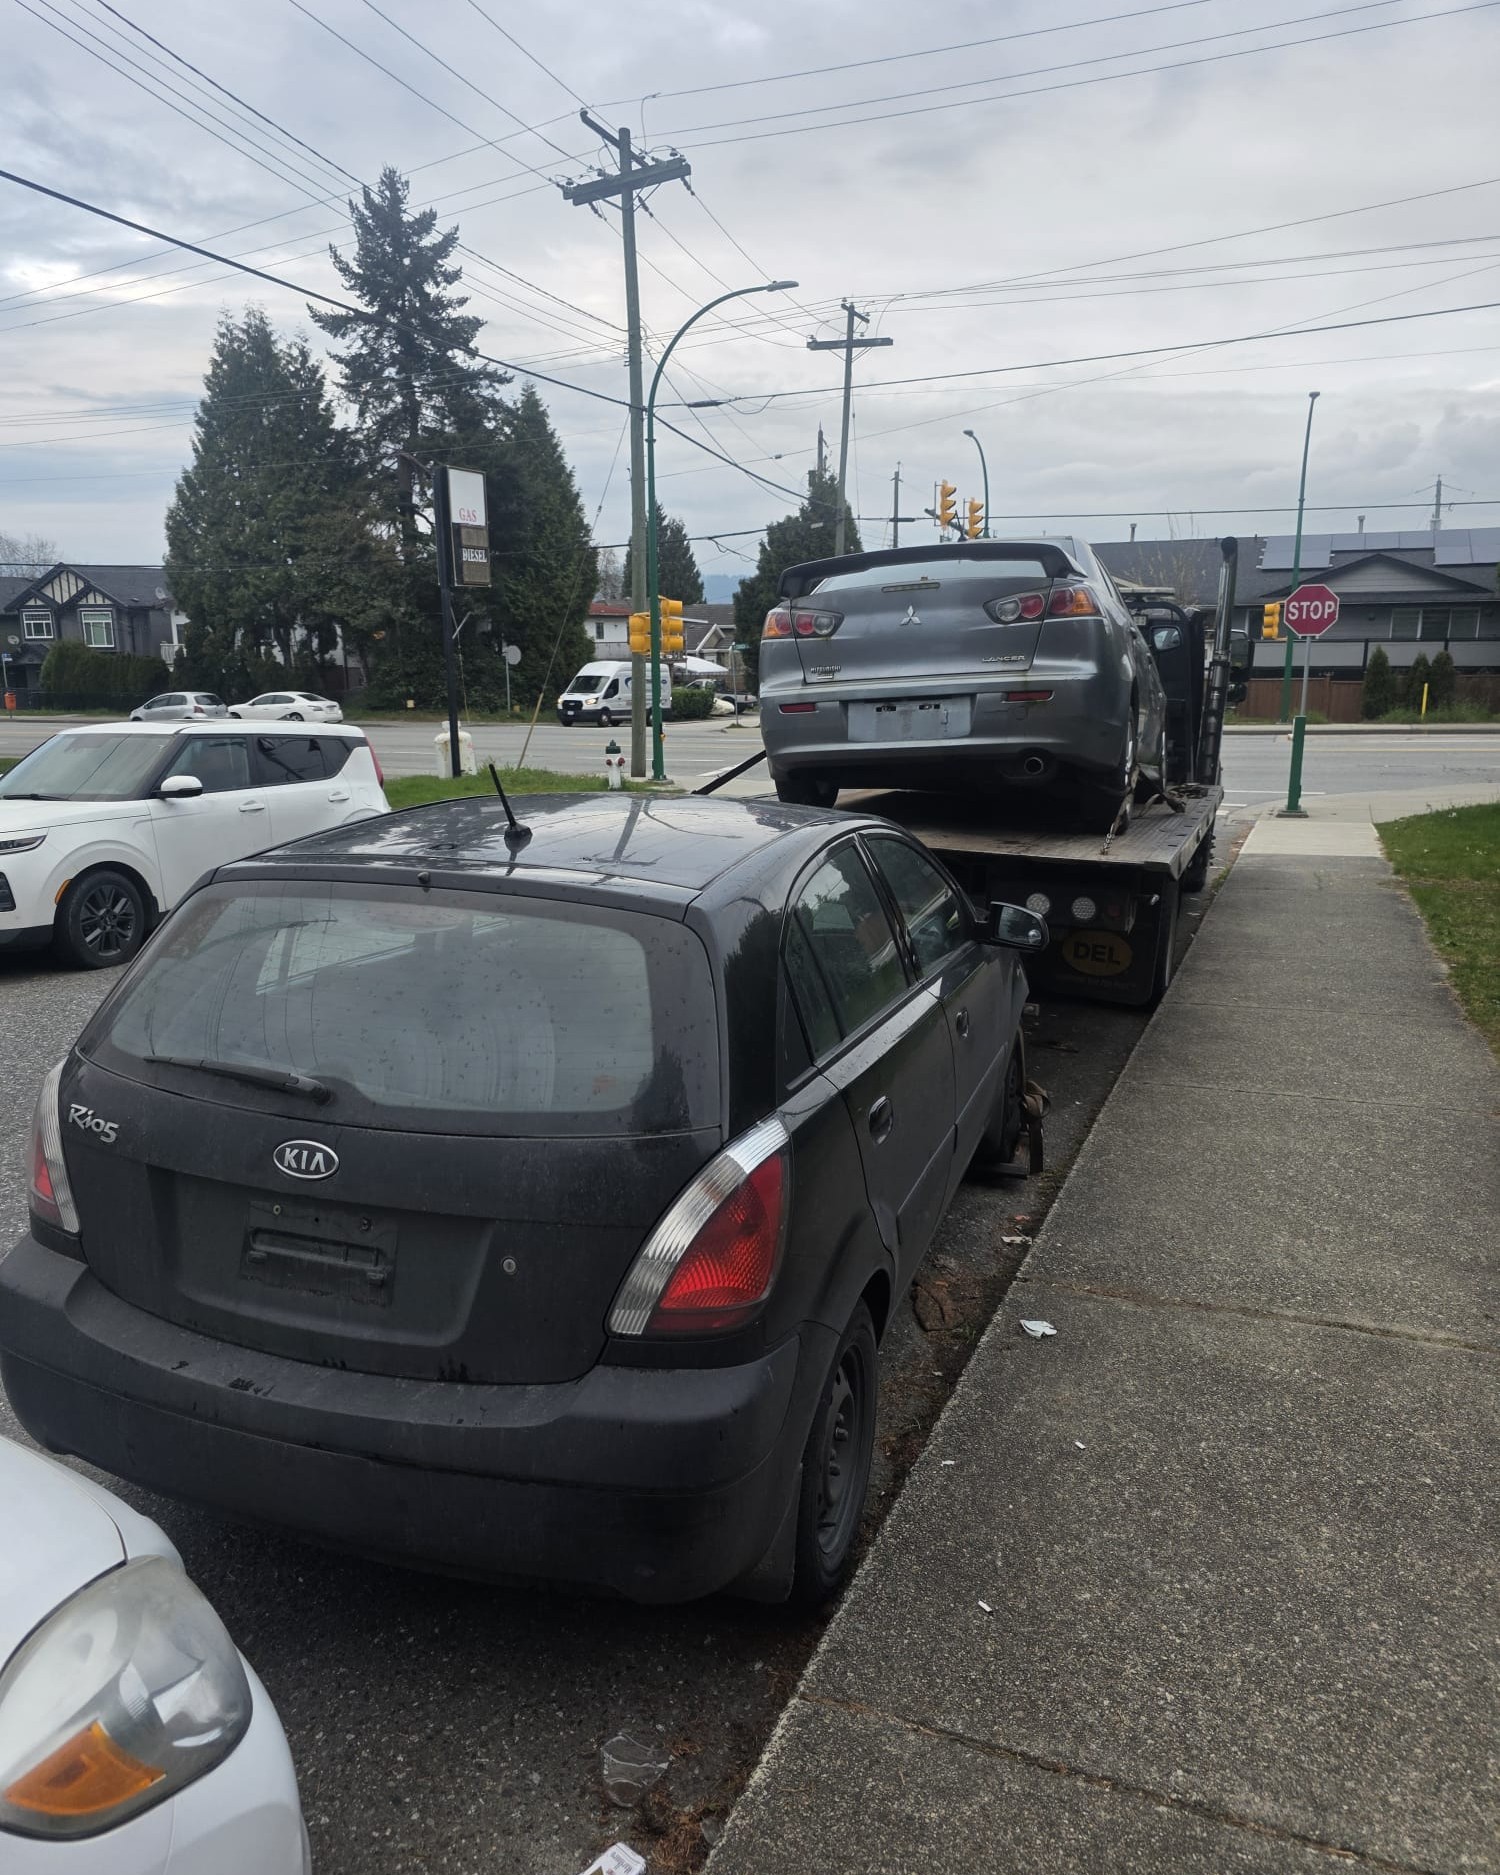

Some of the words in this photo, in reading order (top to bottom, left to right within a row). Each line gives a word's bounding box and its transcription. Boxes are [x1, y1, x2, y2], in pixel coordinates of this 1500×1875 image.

[459, 507, 477, 522] GAS
[462, 548, 488, 563] DIESEL
[1288, 601, 1335, 620] STOP
[1074, 943, 1120, 966] DEL
[68, 1103, 120, 1143] Rio5
[283, 1147, 326, 1173] KIA
